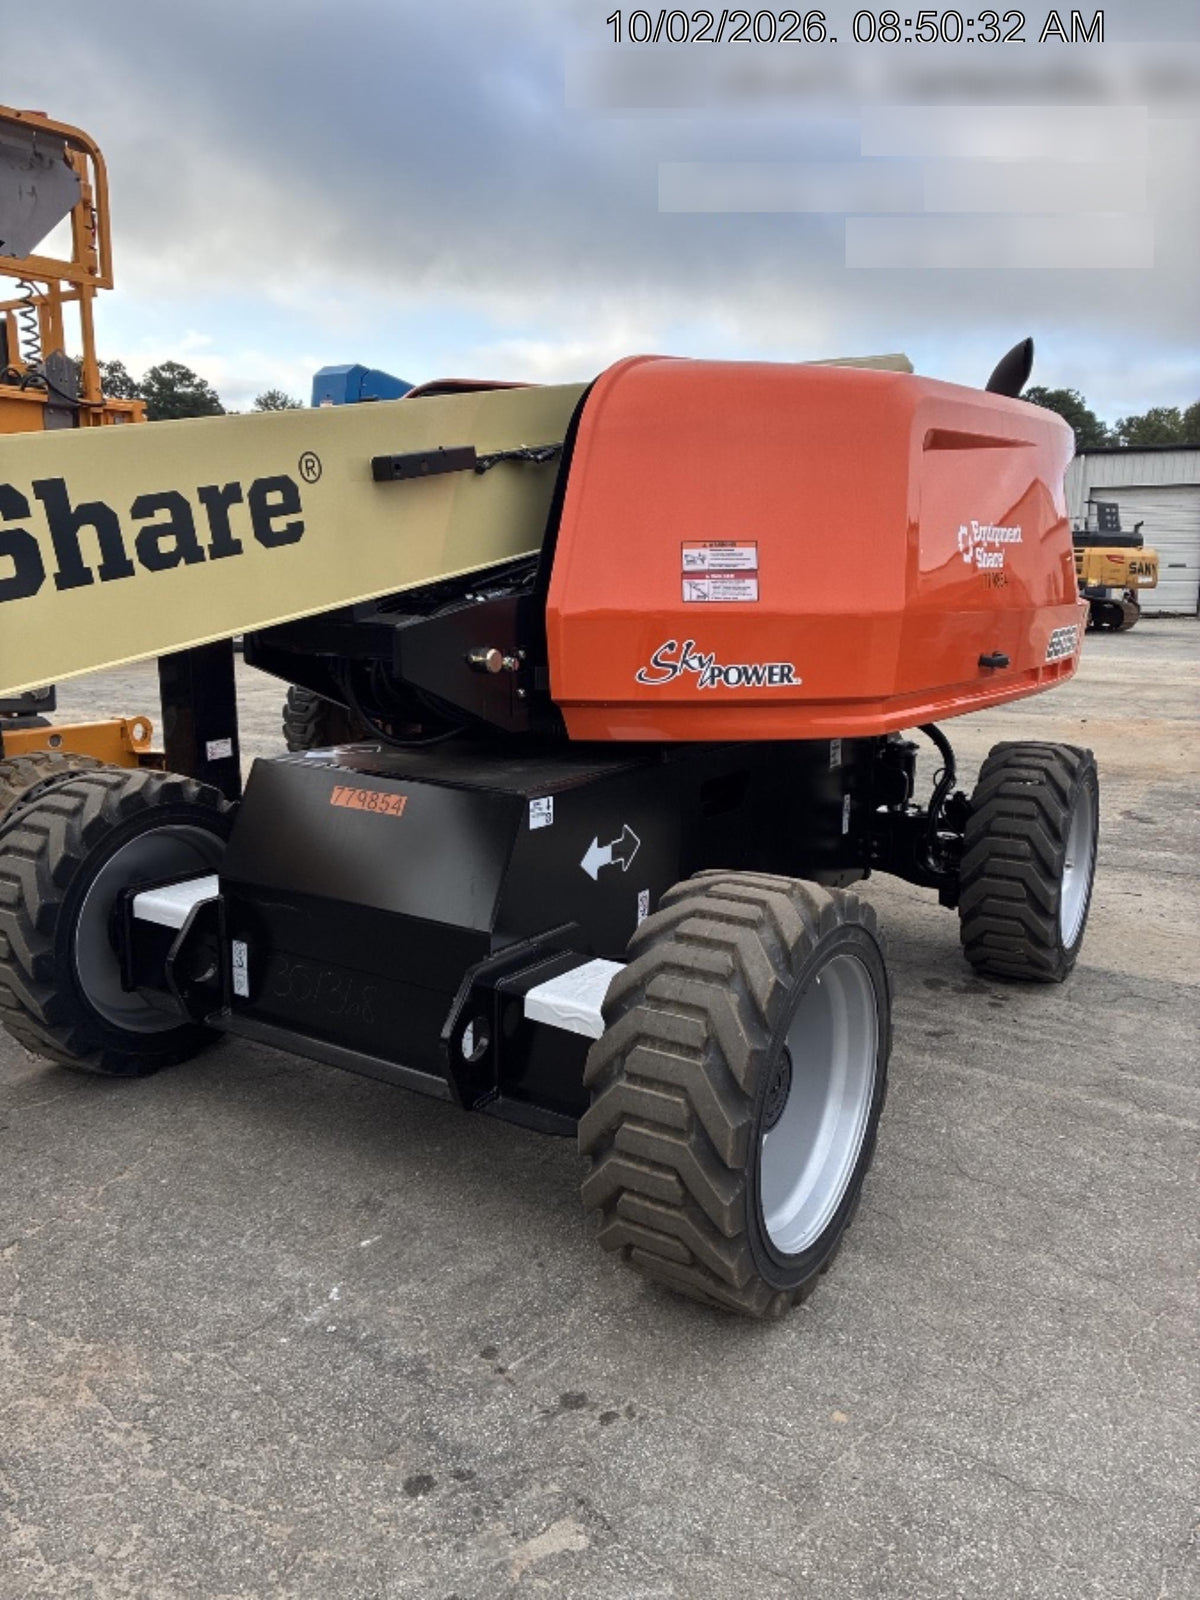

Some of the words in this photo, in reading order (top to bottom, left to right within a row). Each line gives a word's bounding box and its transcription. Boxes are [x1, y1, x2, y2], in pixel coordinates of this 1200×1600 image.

[0, 474, 304, 601] Share
[635, 640, 715, 690] Sky
[706, 663, 797, 687] POWER
[334, 787, 404, 815] 779854
